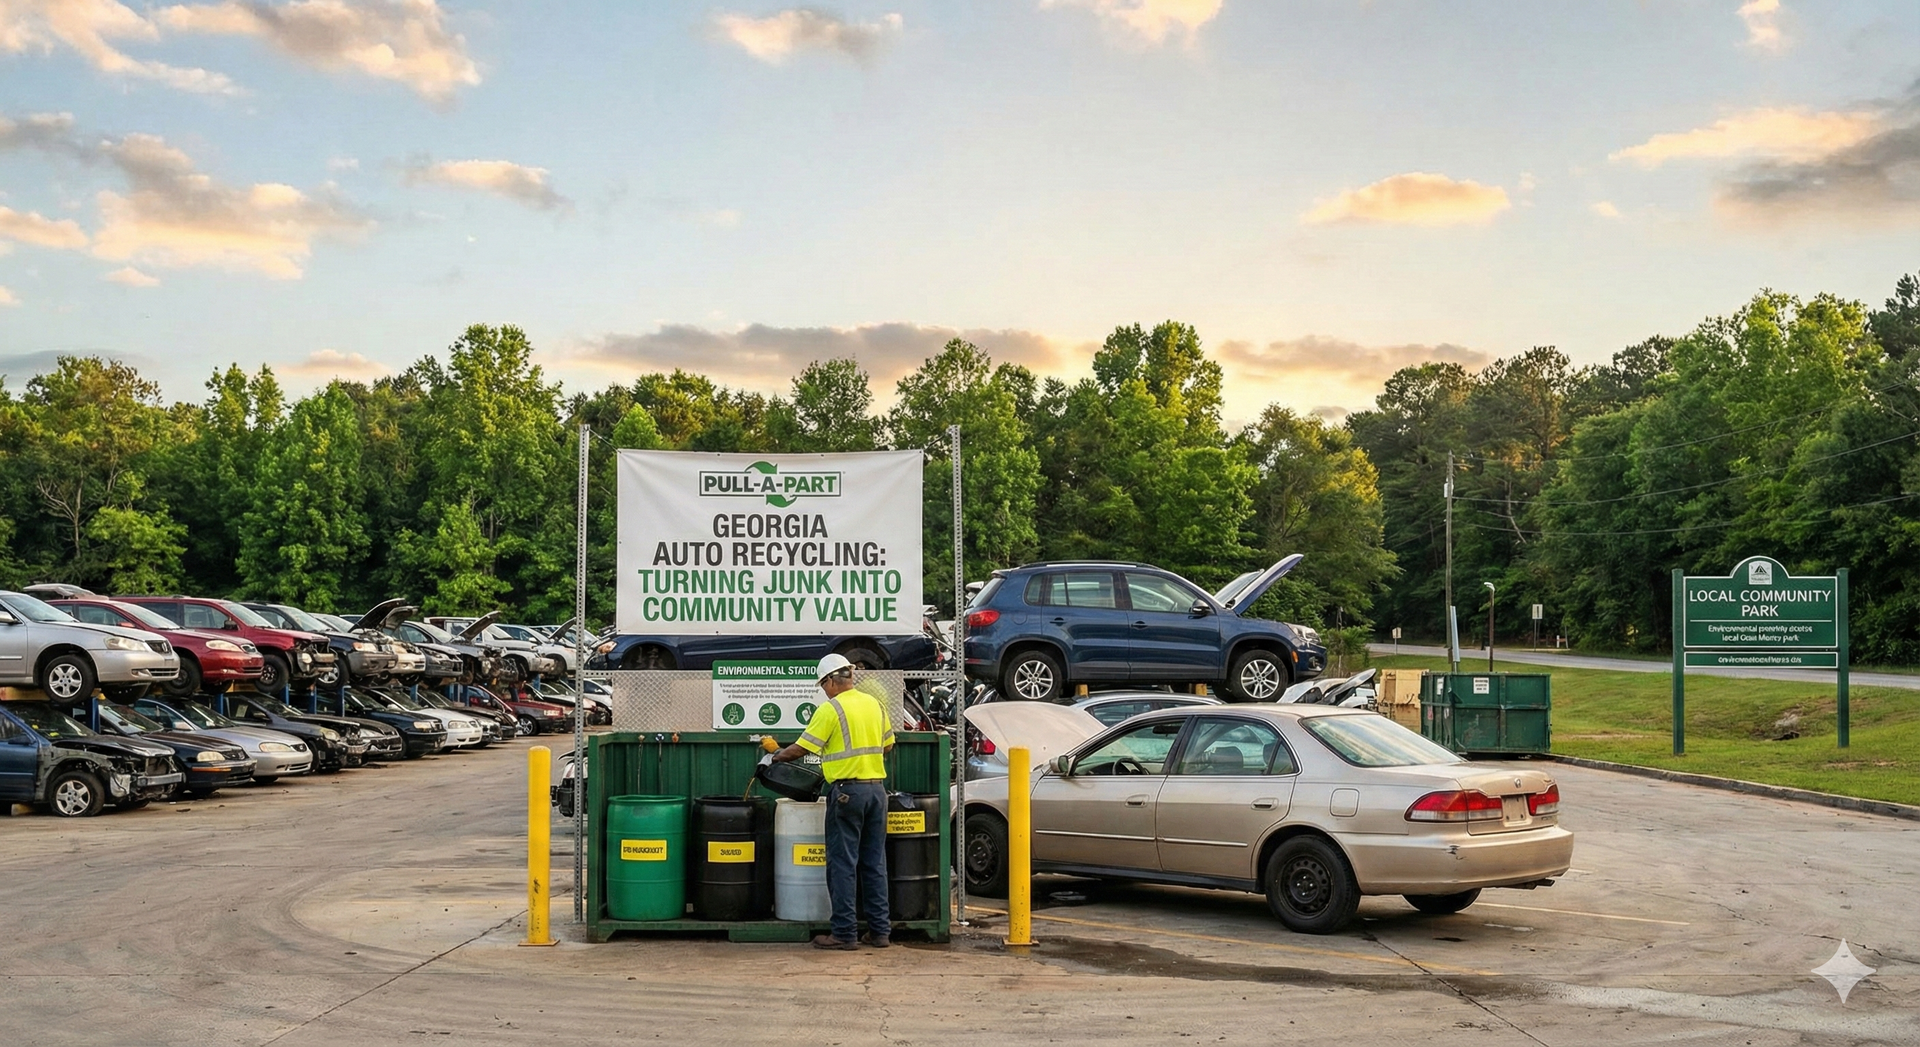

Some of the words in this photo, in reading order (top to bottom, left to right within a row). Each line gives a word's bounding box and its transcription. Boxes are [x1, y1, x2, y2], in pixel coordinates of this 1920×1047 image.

[704, 475, 837, 493] PULL-A-PART
[713, 513, 828, 538] GEORGIA
[652, 542, 723, 566] AUTO
[732, 541, 886, 566] RECYCLING:
[638, 569, 755, 594] TURNING
[763, 569, 833, 594] JUNK
[842, 569, 902, 594] INTO
[1689, 590, 1736, 602] LOCAL
[1740, 589, 1831, 602] COMMUNITY
[643, 597, 805, 622] COMMUNITY
[814, 597, 897, 622] VALUE
[1742, 605, 1779, 617] PARK
[717, 665, 786, 675] ENVIRONMENTAL
[787, 665, 817, 675] STATIO
